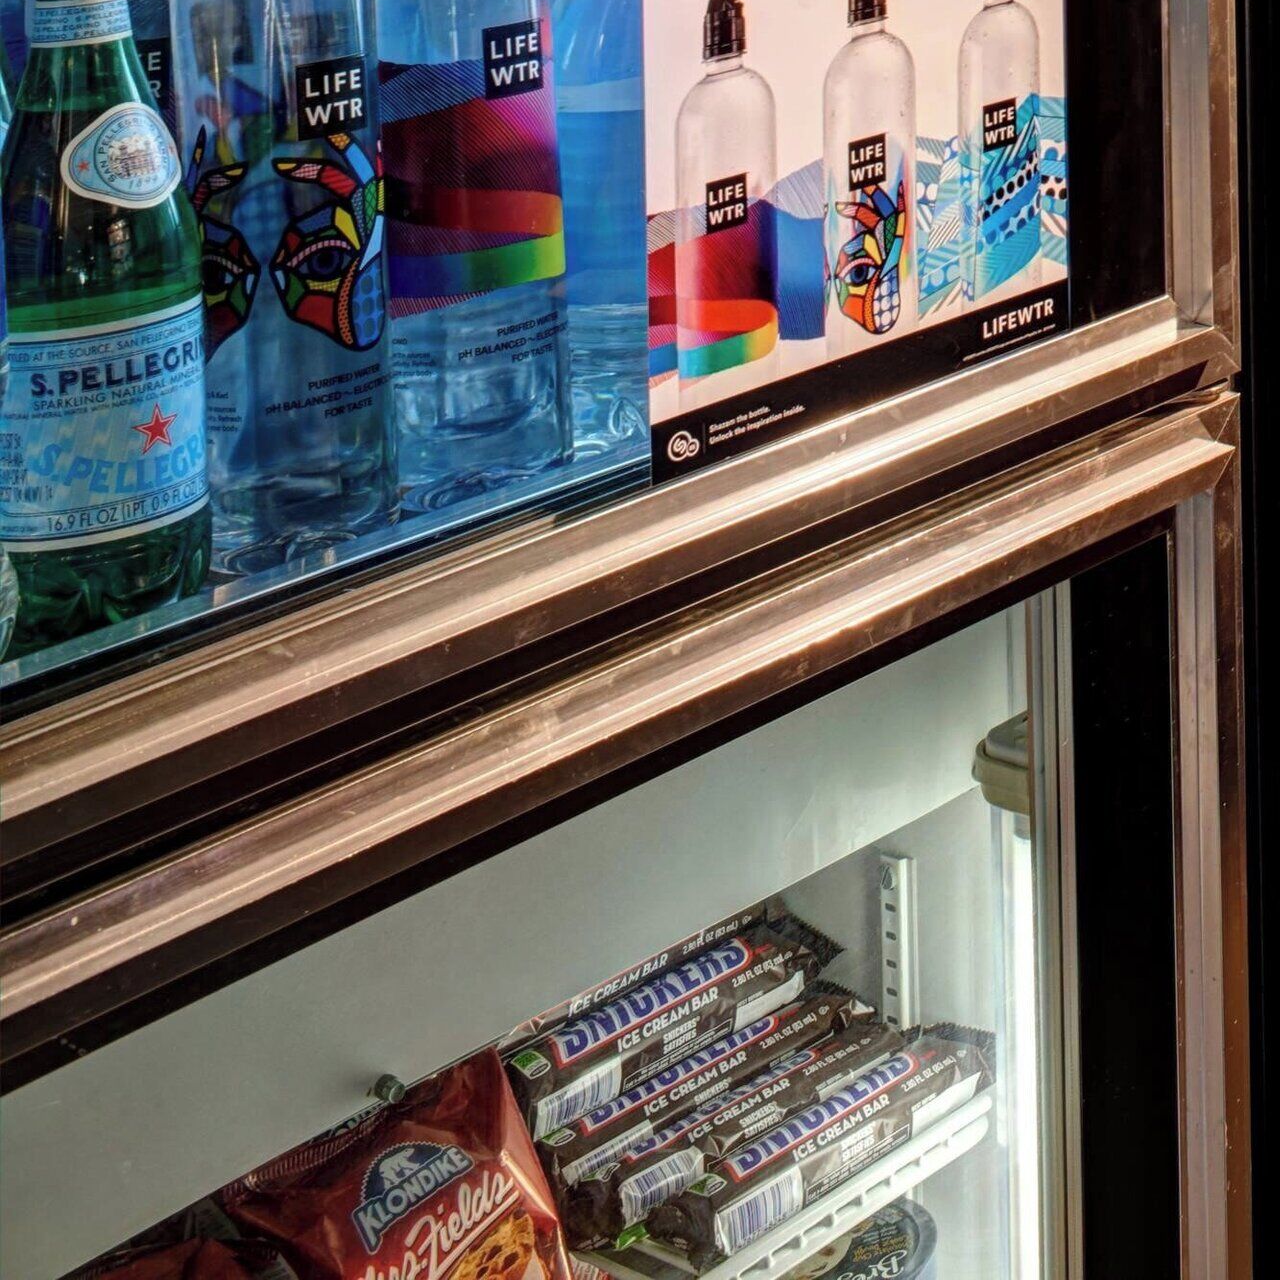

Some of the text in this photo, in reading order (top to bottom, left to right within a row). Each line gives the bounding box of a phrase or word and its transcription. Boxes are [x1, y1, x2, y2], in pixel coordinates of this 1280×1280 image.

[489, 33, 539, 63] LIFE
[304, 69, 362, 99] LIFE
[490, 60, 540, 90] WTR
[304, 97, 363, 127] WTR
[984, 106, 1017, 128] LIFE
[985, 125, 1016, 146] WTR
[850, 143, 885, 166] LIFE
[850, 161, 885, 184] WTR
[708, 180, 746, 206] LIFE
[708, 201, 746, 226] WTR
[983, 297, 1054, 341] LIFEWTR
[34, 380, 166, 412] SPARKLING NATURAL
[562, 937, 747, 1059] SNICKERS
[617, 986, 720, 1053] ICE CREAM BAR
[643, 1051, 748, 1117] ICE CREAM BAR
[792, 1094, 890, 1161] ICE CREAM BAR
[357, 1147, 468, 1247] KLONDIKE
